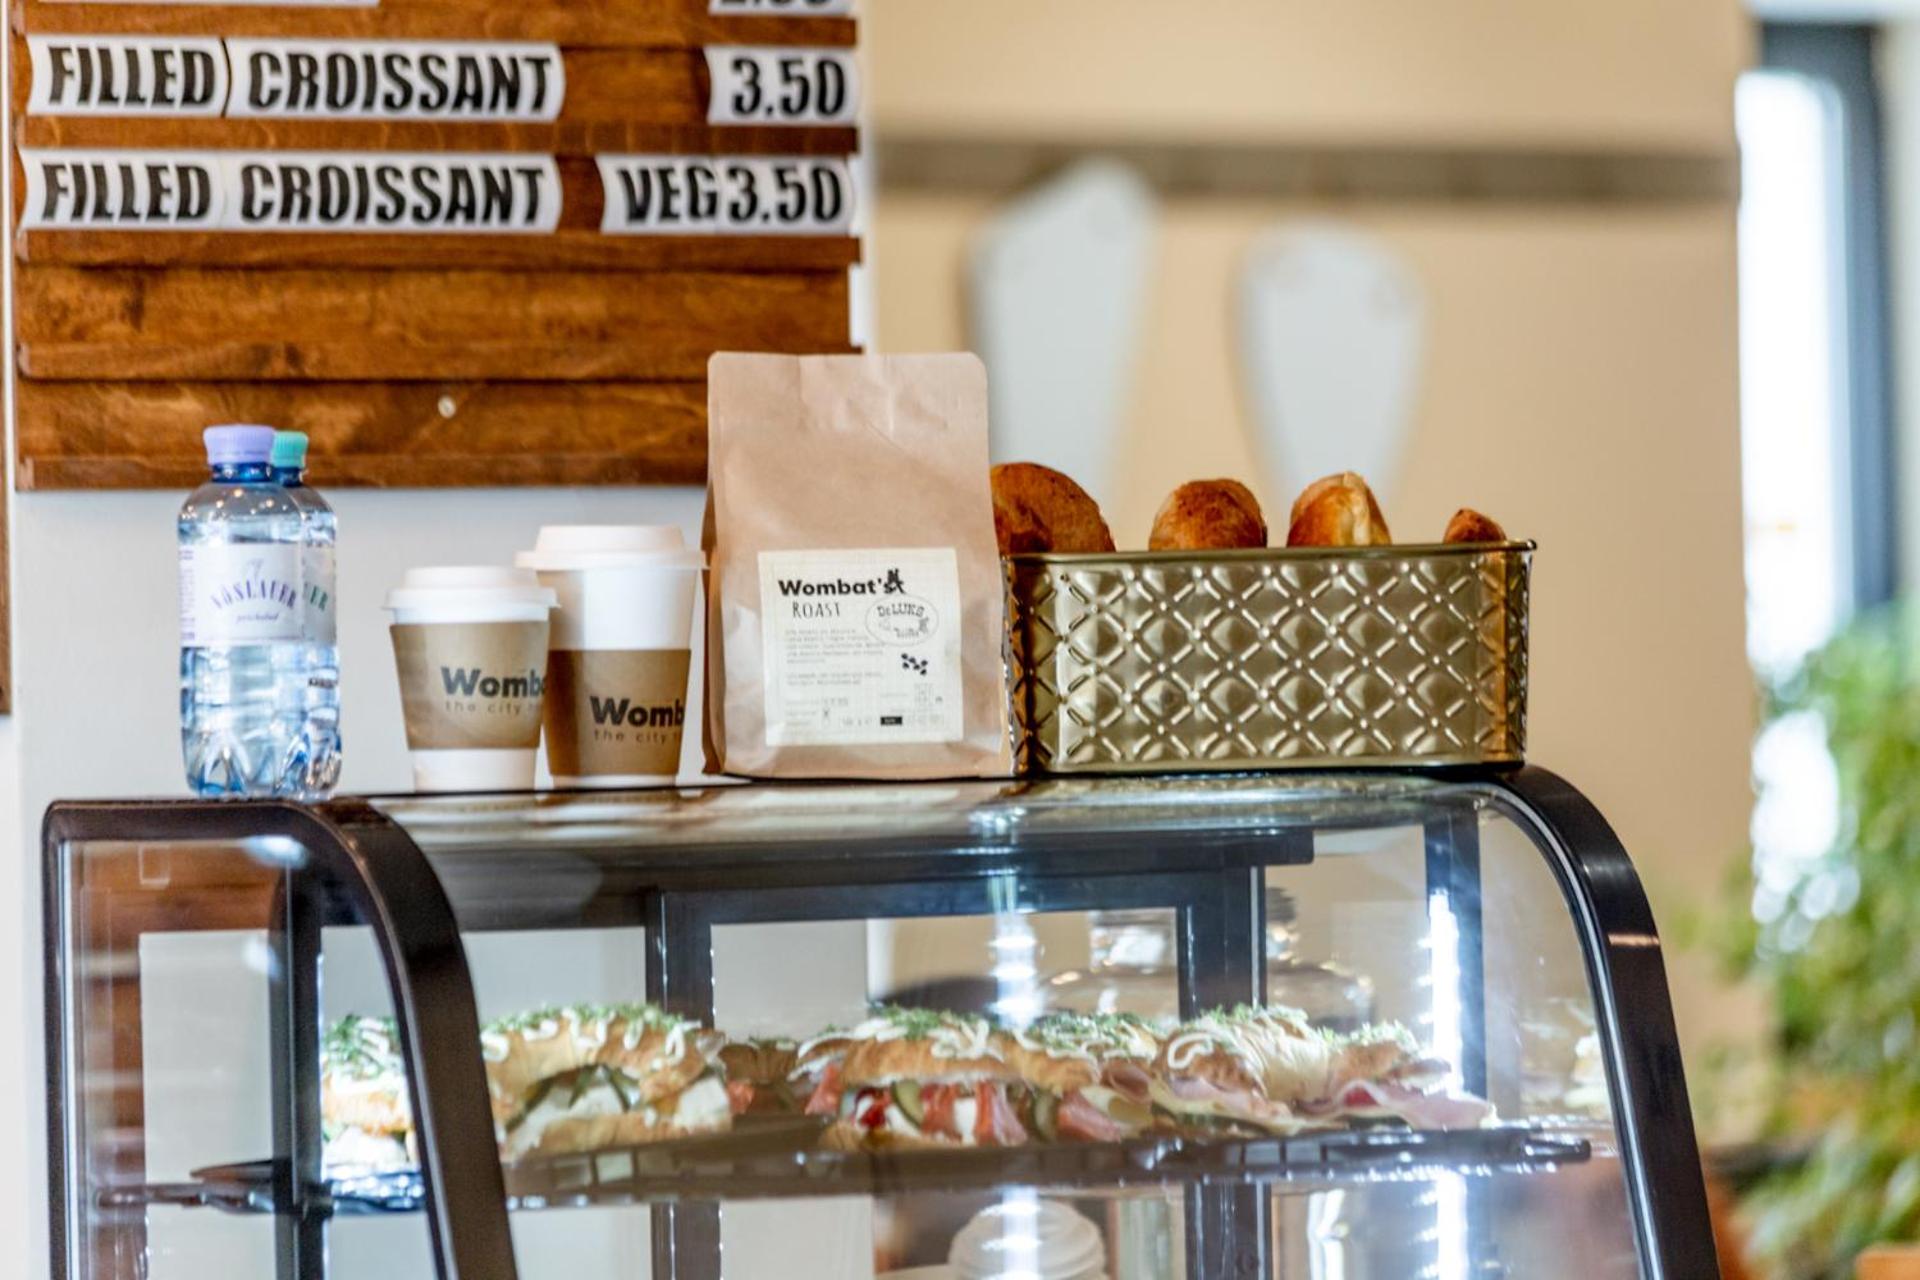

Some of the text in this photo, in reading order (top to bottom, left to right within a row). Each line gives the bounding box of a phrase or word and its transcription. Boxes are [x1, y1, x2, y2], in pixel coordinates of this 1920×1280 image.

[47, 44, 846, 117] FILLED CROISSANT 3.50
[40, 162, 842, 226] FILLED CROISSANT VEG 3.50
[777, 577, 897, 597] Wombat's
[791, 600, 841, 619] ROAST
[445, 700, 477, 713] the
[487, 702, 523, 716] city
[594, 728, 625, 741] the
